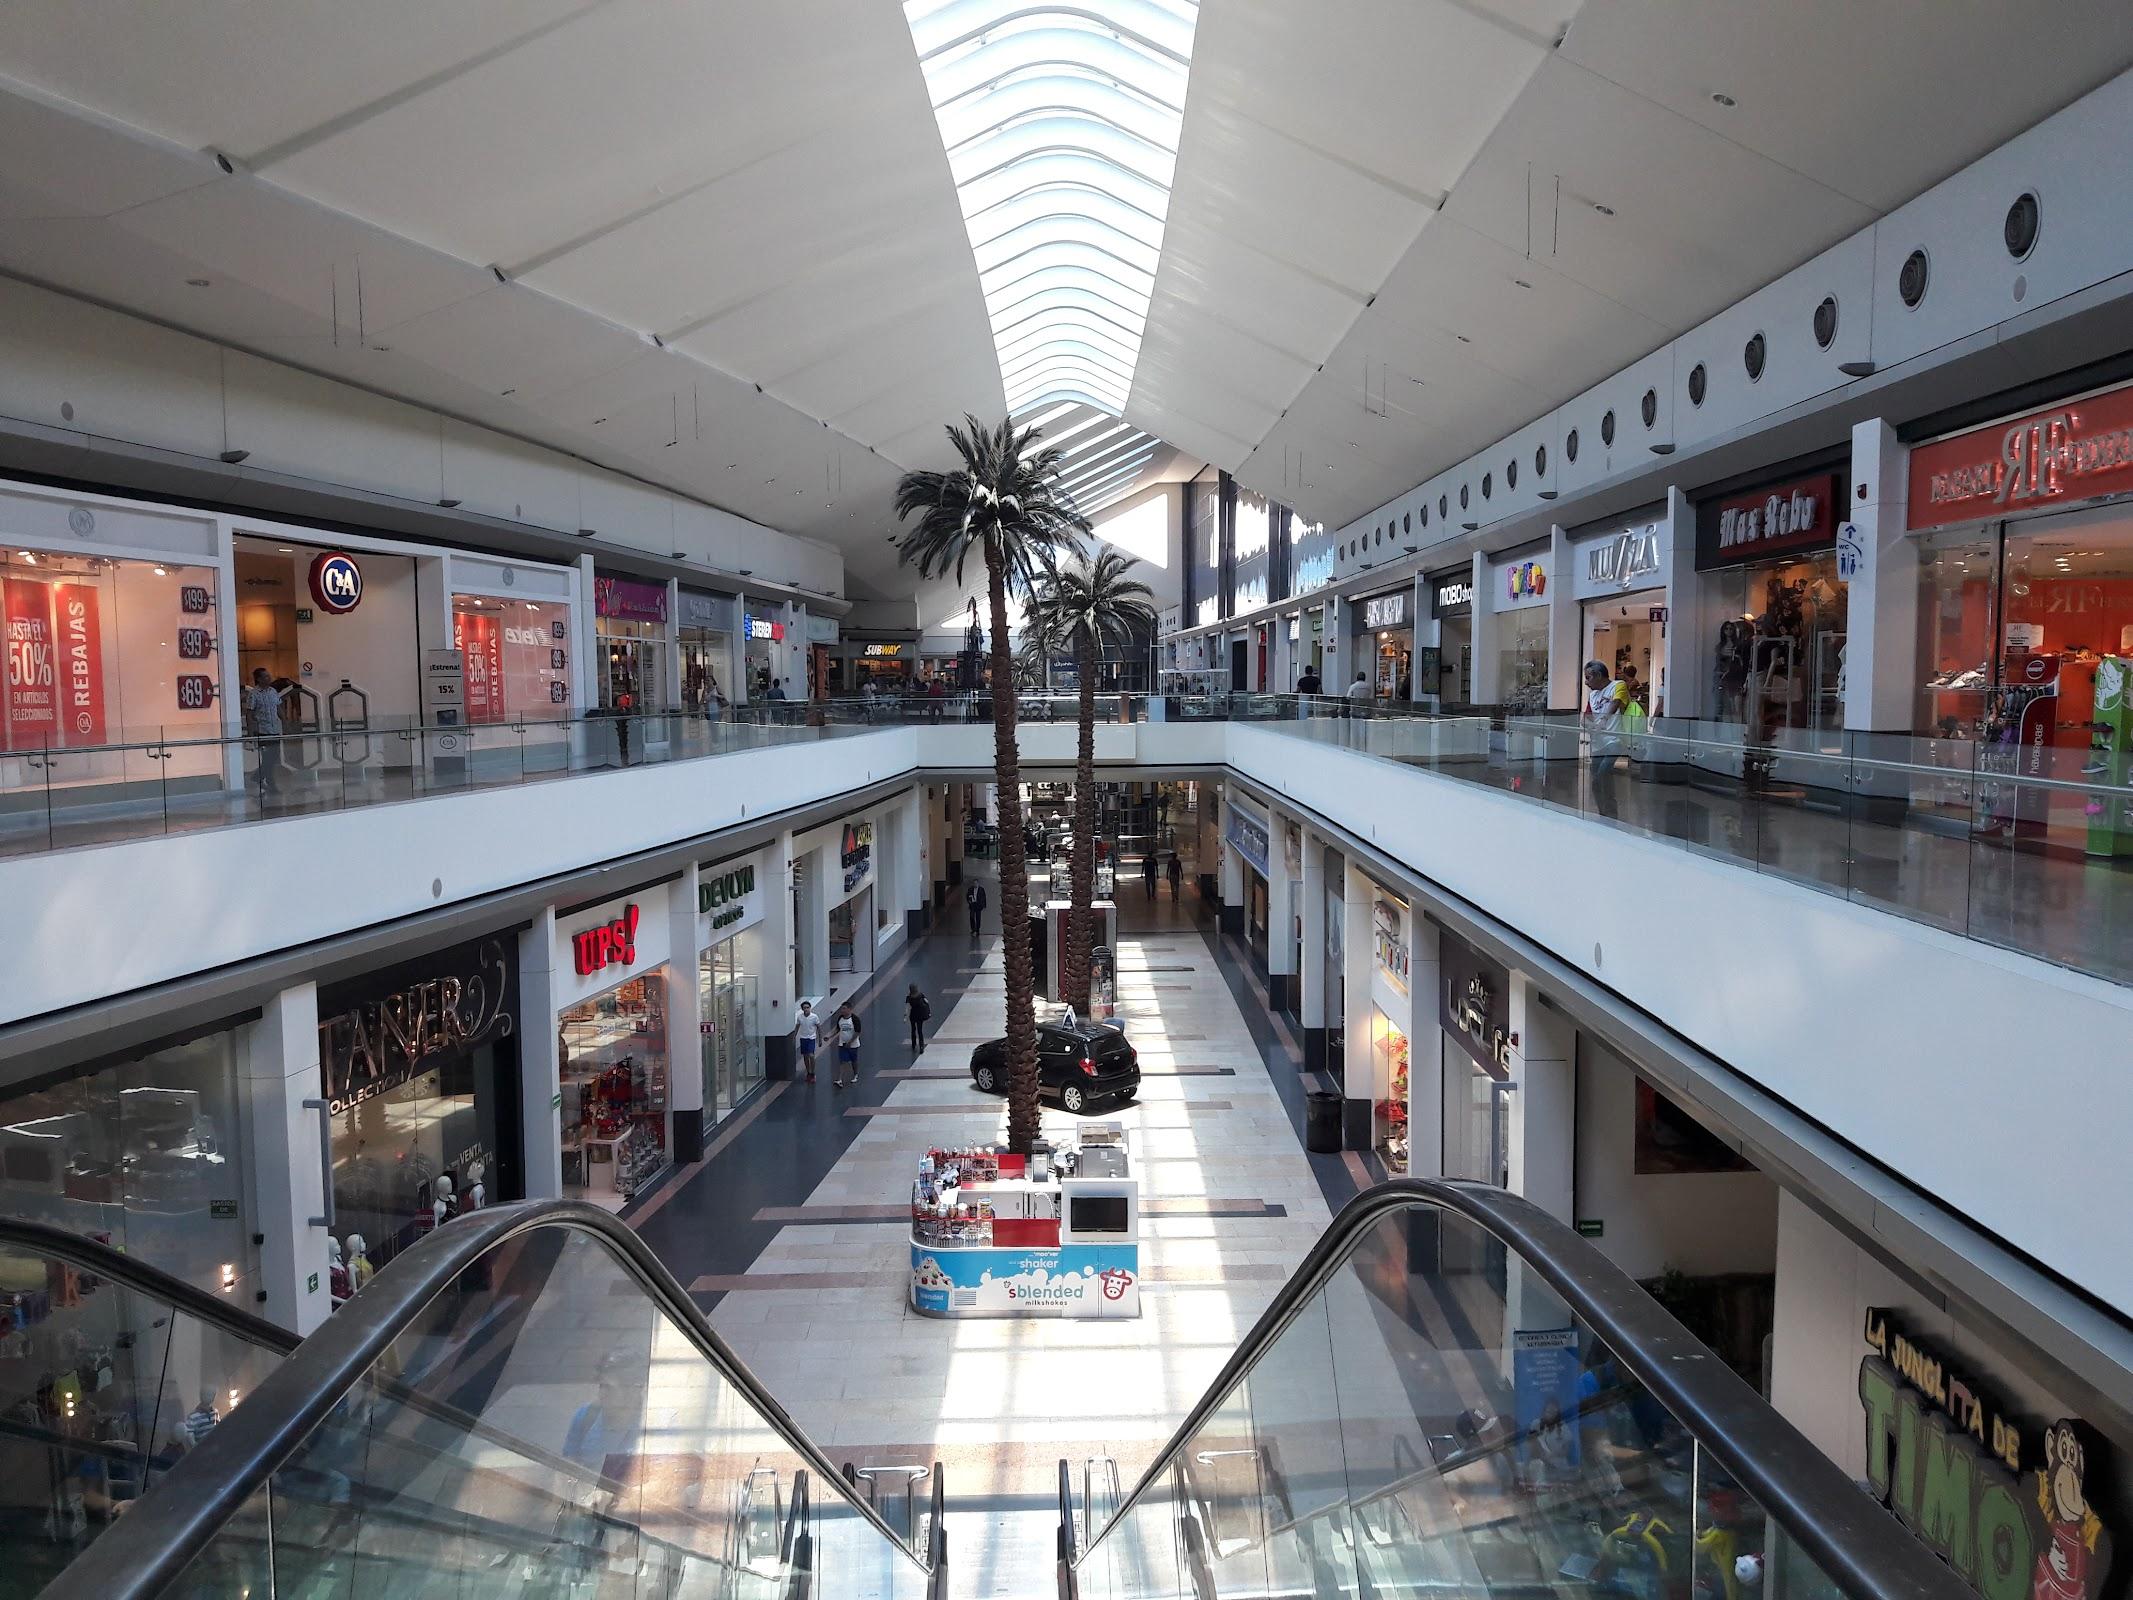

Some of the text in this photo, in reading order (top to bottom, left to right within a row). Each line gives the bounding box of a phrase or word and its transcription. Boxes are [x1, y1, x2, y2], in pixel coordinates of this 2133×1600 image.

[325, 567, 357, 596] C&A
[184, 588, 204, 611] $199
[1439, 584, 1462, 607] MOBO
[7, 621, 32, 641] HASTA
[751, 620, 772, 638] STEREN
[69, 600, 91, 707] REBAJAS
[182, 630, 202, 656] $99
[864, 644, 902, 656] SUBWAY
[8, 641, 52, 687] 50%
[429, 663, 460, 672] ¡Estrena!
[468, 653, 487, 683] 50%
[489, 628, 498, 697] REBAJAS
[181, 678, 203, 706] $69
[438, 685, 455, 694] 15%
[699, 865, 755, 913] DEVLYN
[572, 904, 639, 976] UPS!
[459, 1142, 483, 1165] VENTA
[1019, 1260, 1059, 1269] shaker
[1866, 1306, 1887, 1359] LA
[1992, 1413, 2021, 1473] DE
[1862, 1358, 2034, 1600] TIMO
